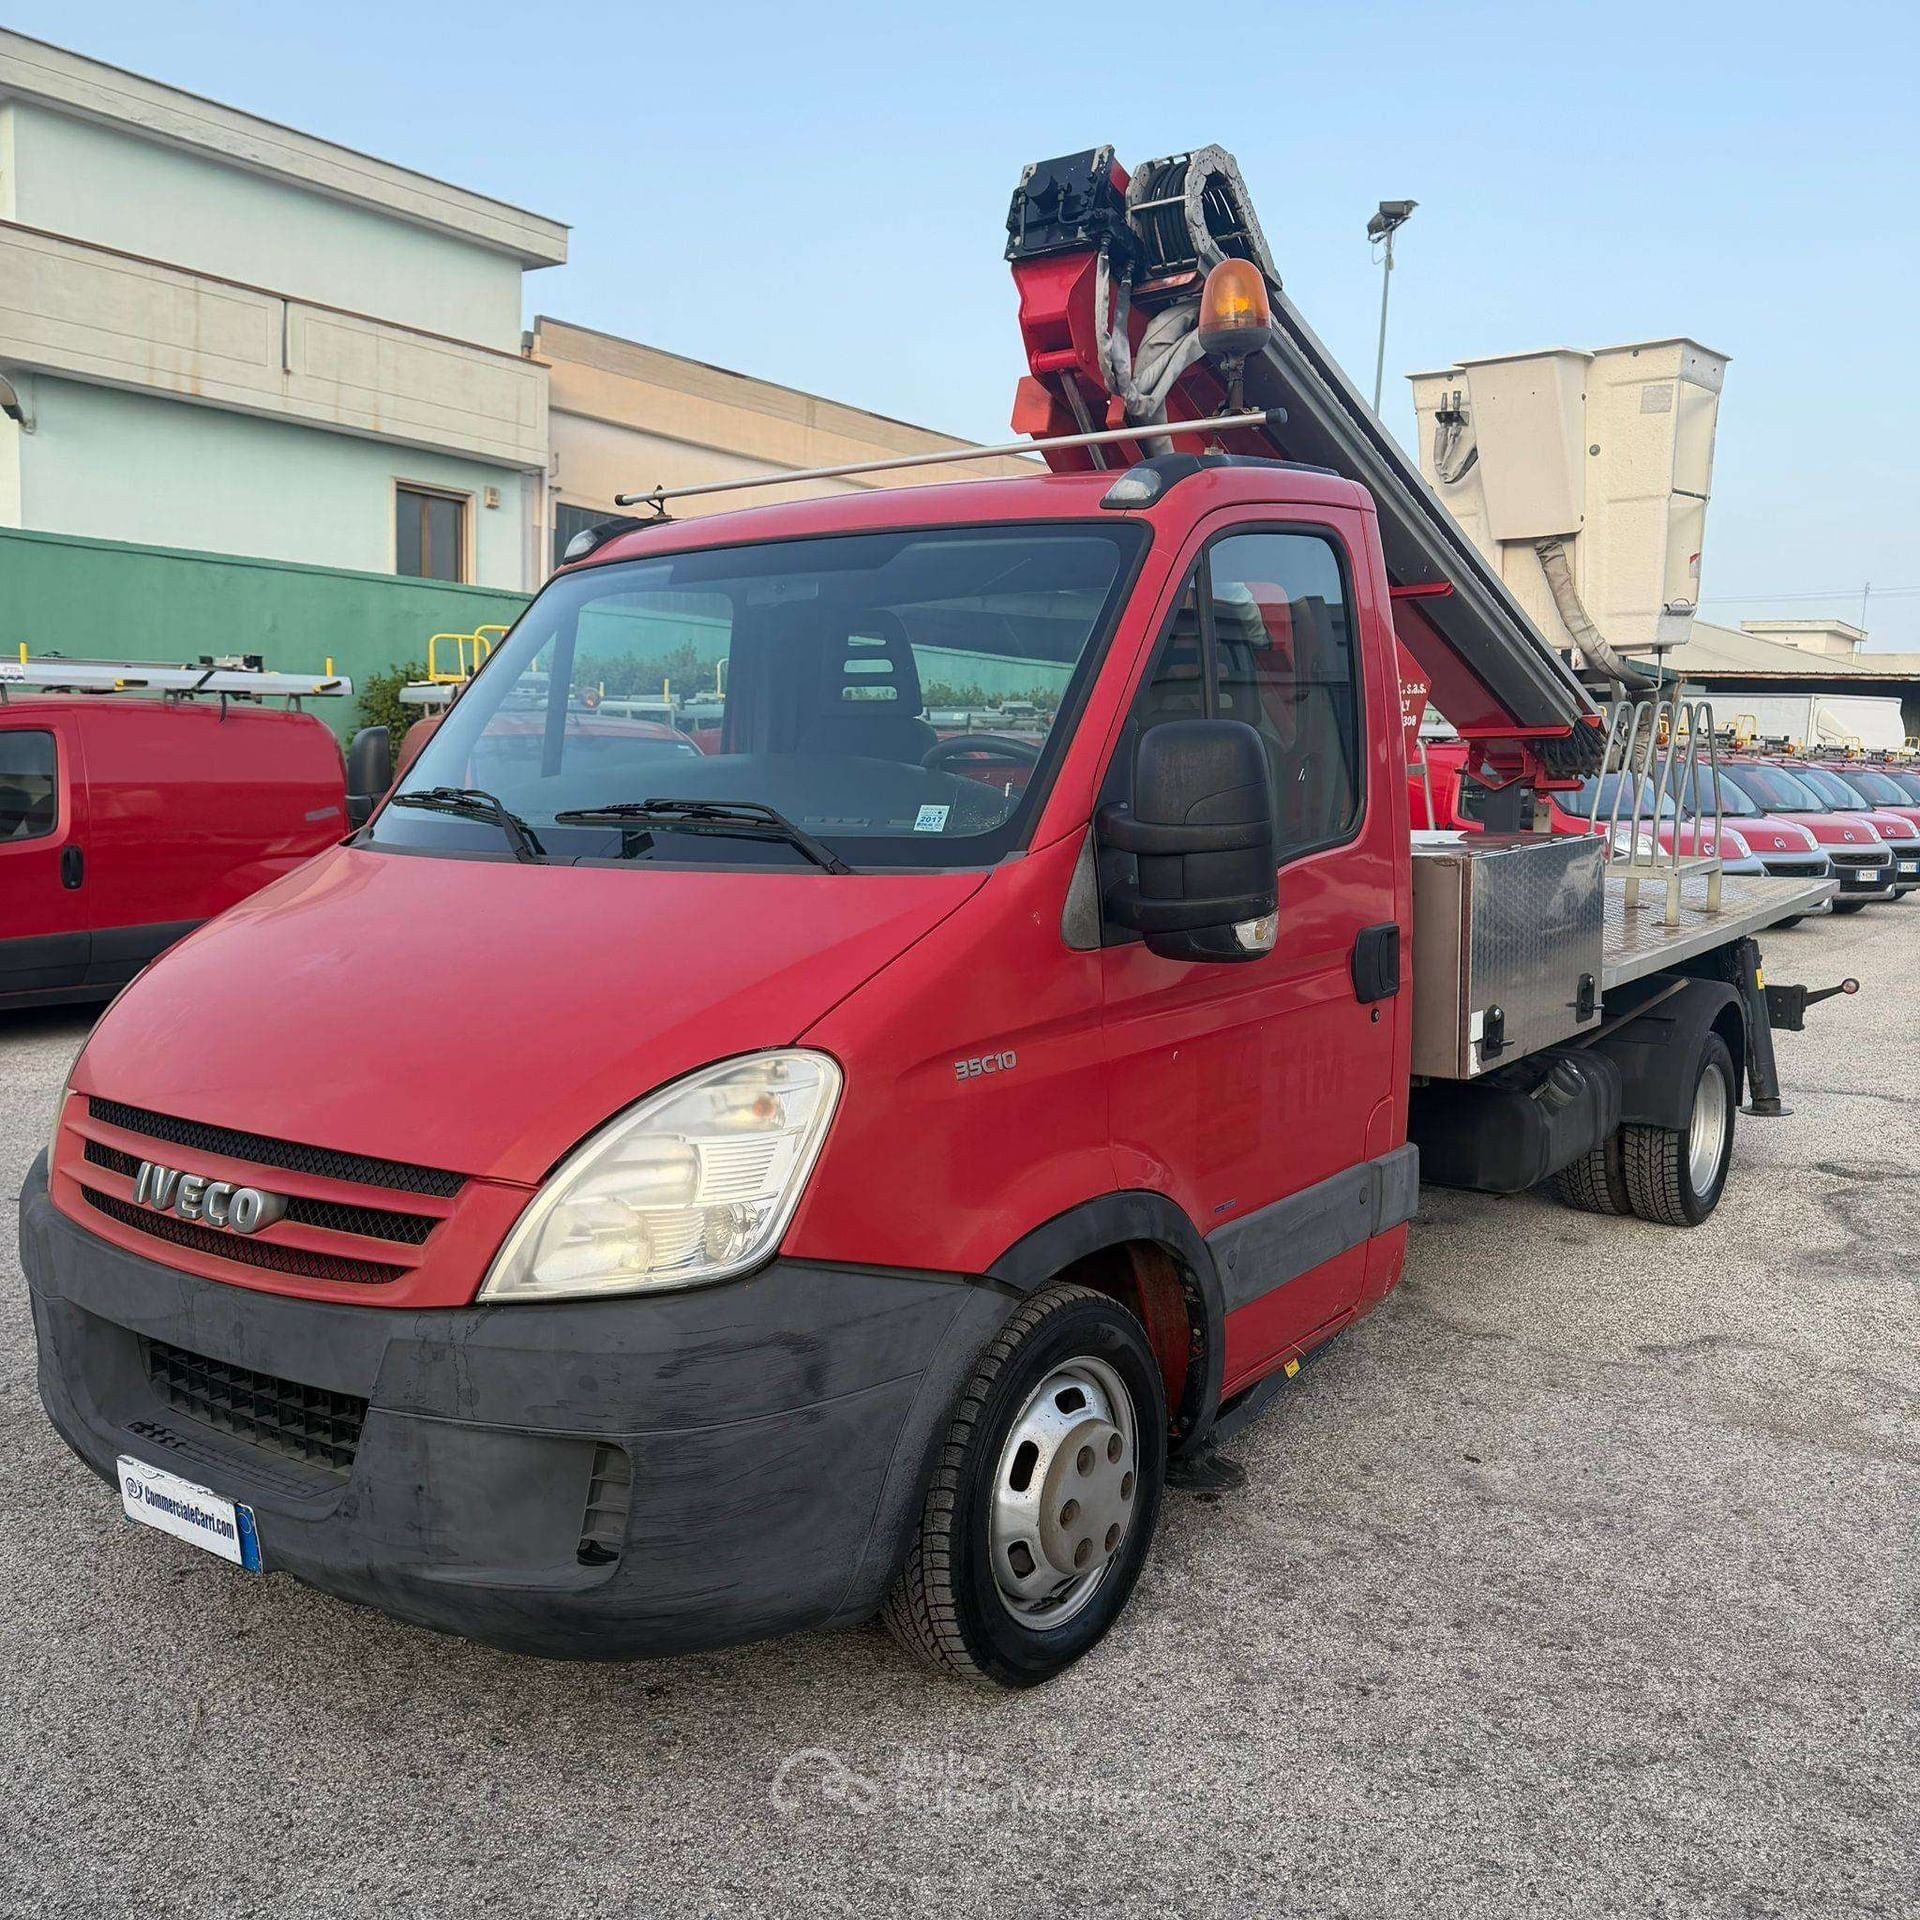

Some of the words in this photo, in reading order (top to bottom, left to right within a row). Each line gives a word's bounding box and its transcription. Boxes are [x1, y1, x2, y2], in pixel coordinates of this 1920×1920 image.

[954, 1050, 1017, 1081] 35C10
[133, 1160, 280, 1234] IVECO
[144, 1485, 235, 1540] CommercialeCarri.com
